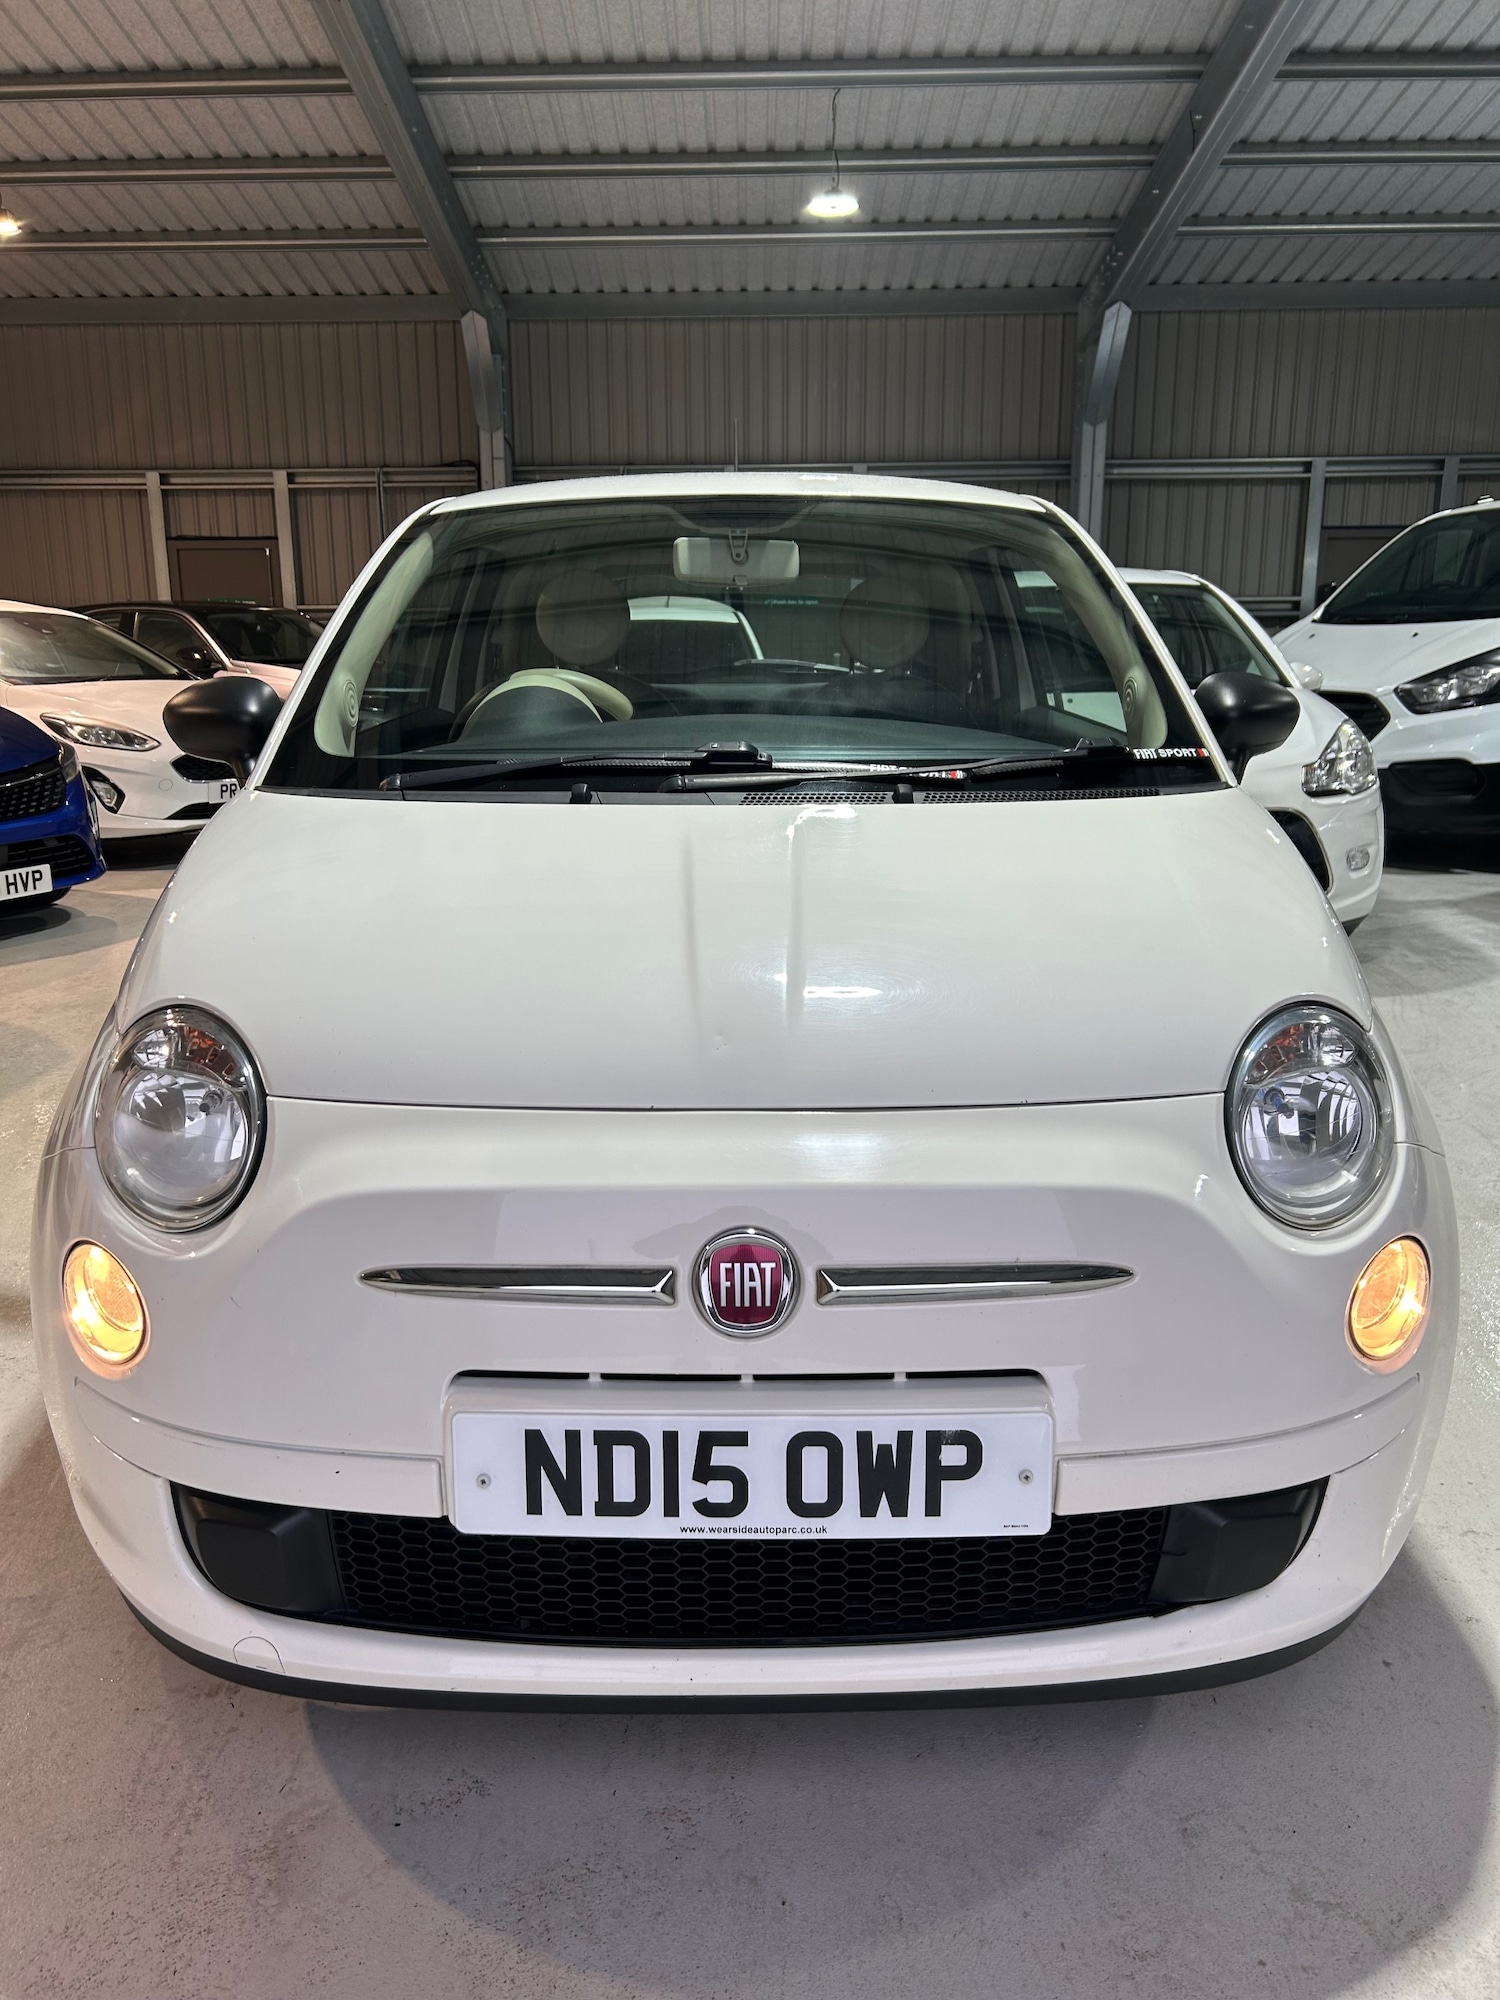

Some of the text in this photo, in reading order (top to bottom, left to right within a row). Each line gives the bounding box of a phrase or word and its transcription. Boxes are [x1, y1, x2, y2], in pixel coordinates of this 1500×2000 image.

[1133, 748, 1197, 760] FIAT SPORT
[220, 783, 238, 799] PR
[5, 870, 43, 895] HVP
[719, 1262, 776, 1308] FIAT
[524, 1428, 983, 1519] ND15 OWP
[679, 1525, 828, 1536] www.wearsideautoparc.co.uk
